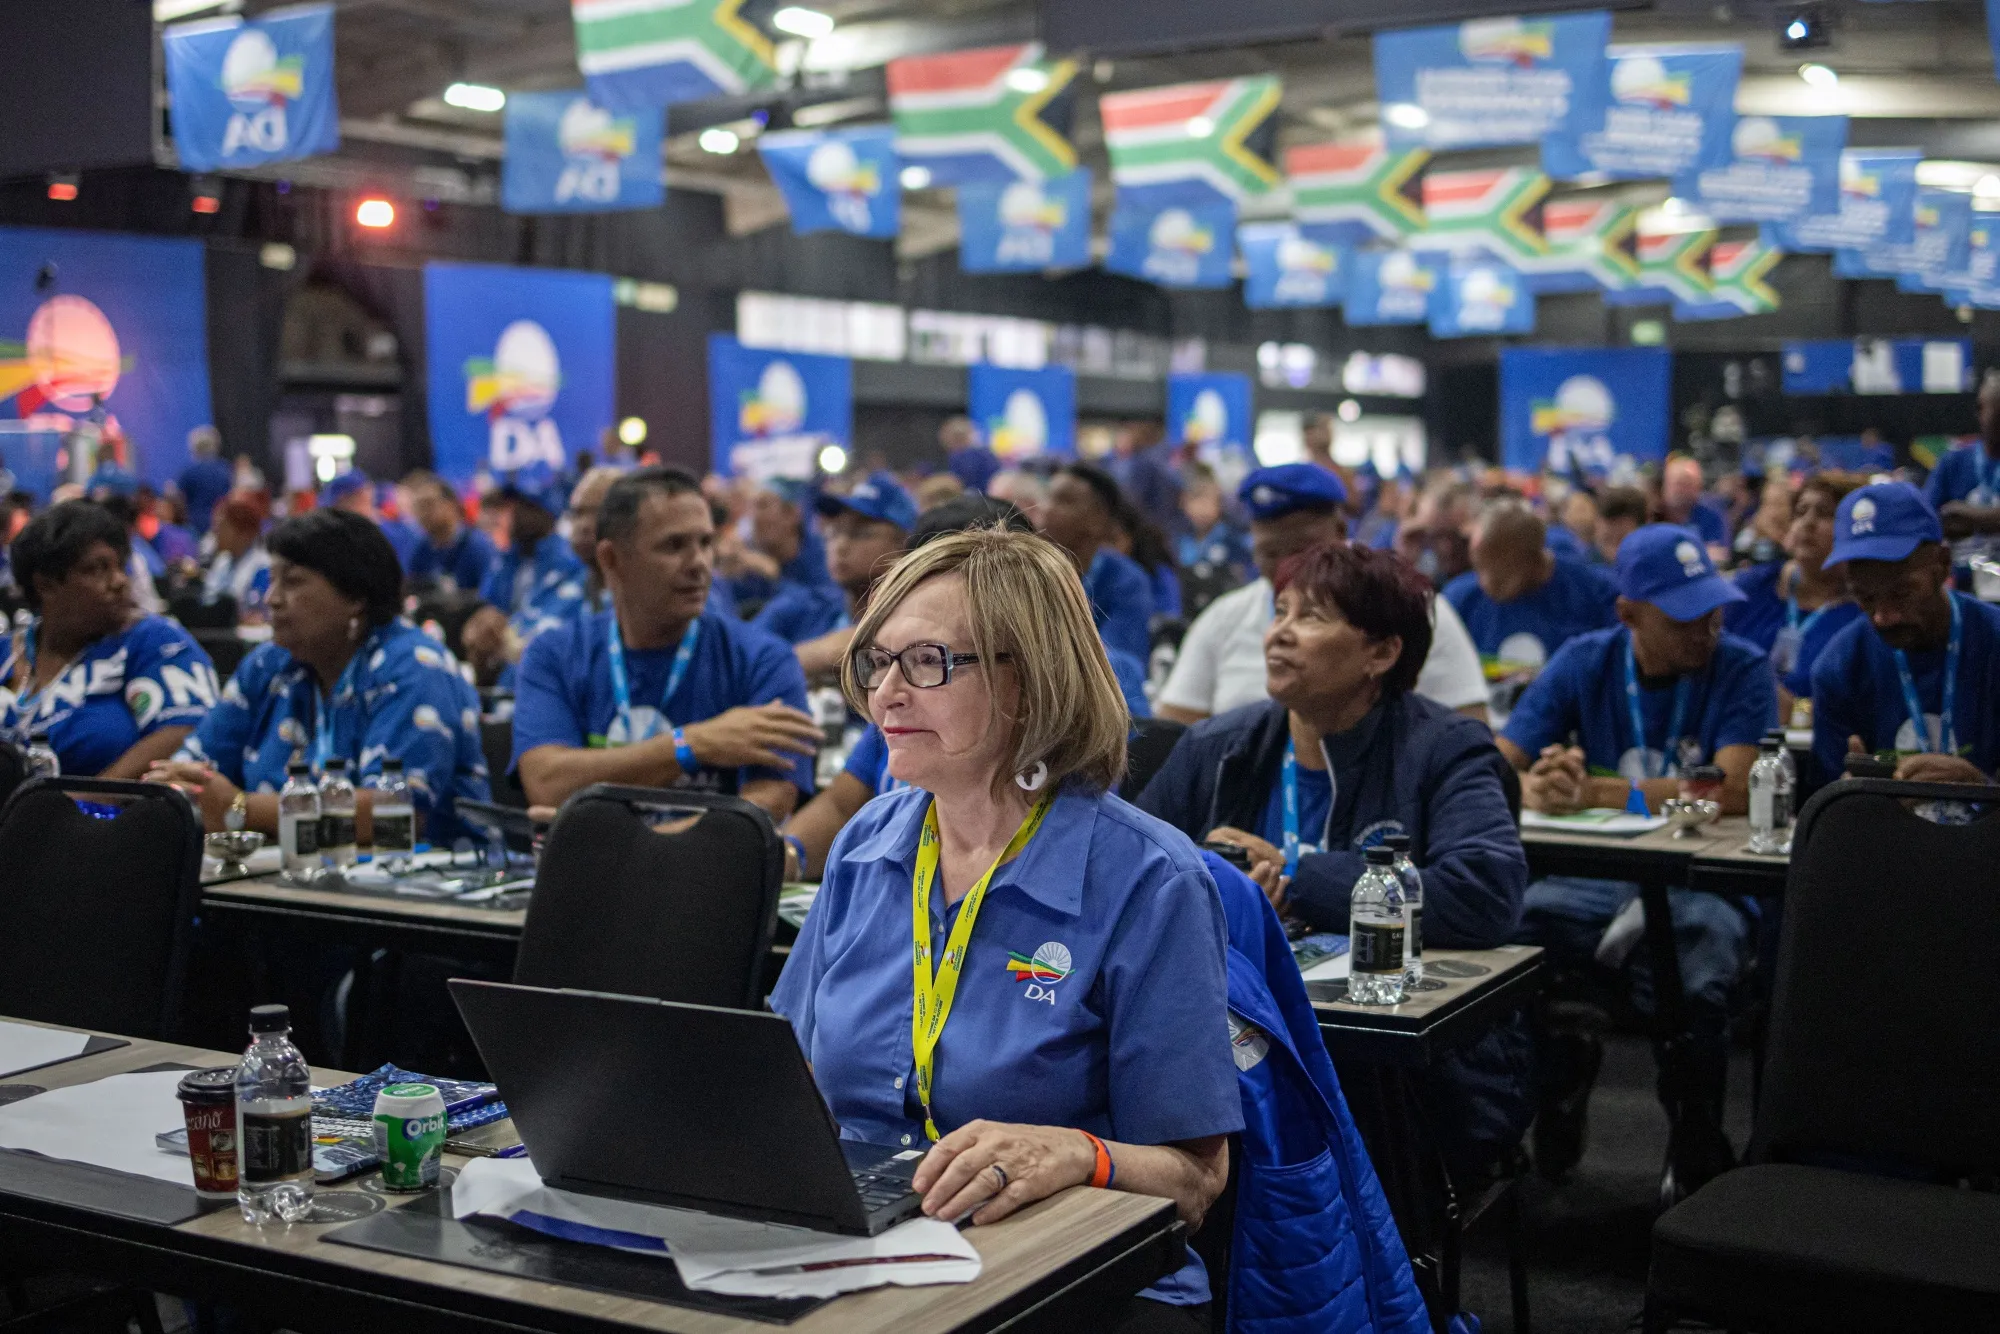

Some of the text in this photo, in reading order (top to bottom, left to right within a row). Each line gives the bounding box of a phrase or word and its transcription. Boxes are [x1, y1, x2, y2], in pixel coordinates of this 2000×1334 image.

[490, 417, 566, 471] DA
[1023, 983, 1056, 1006] DA
[406, 1114, 445, 1137] Orbit
